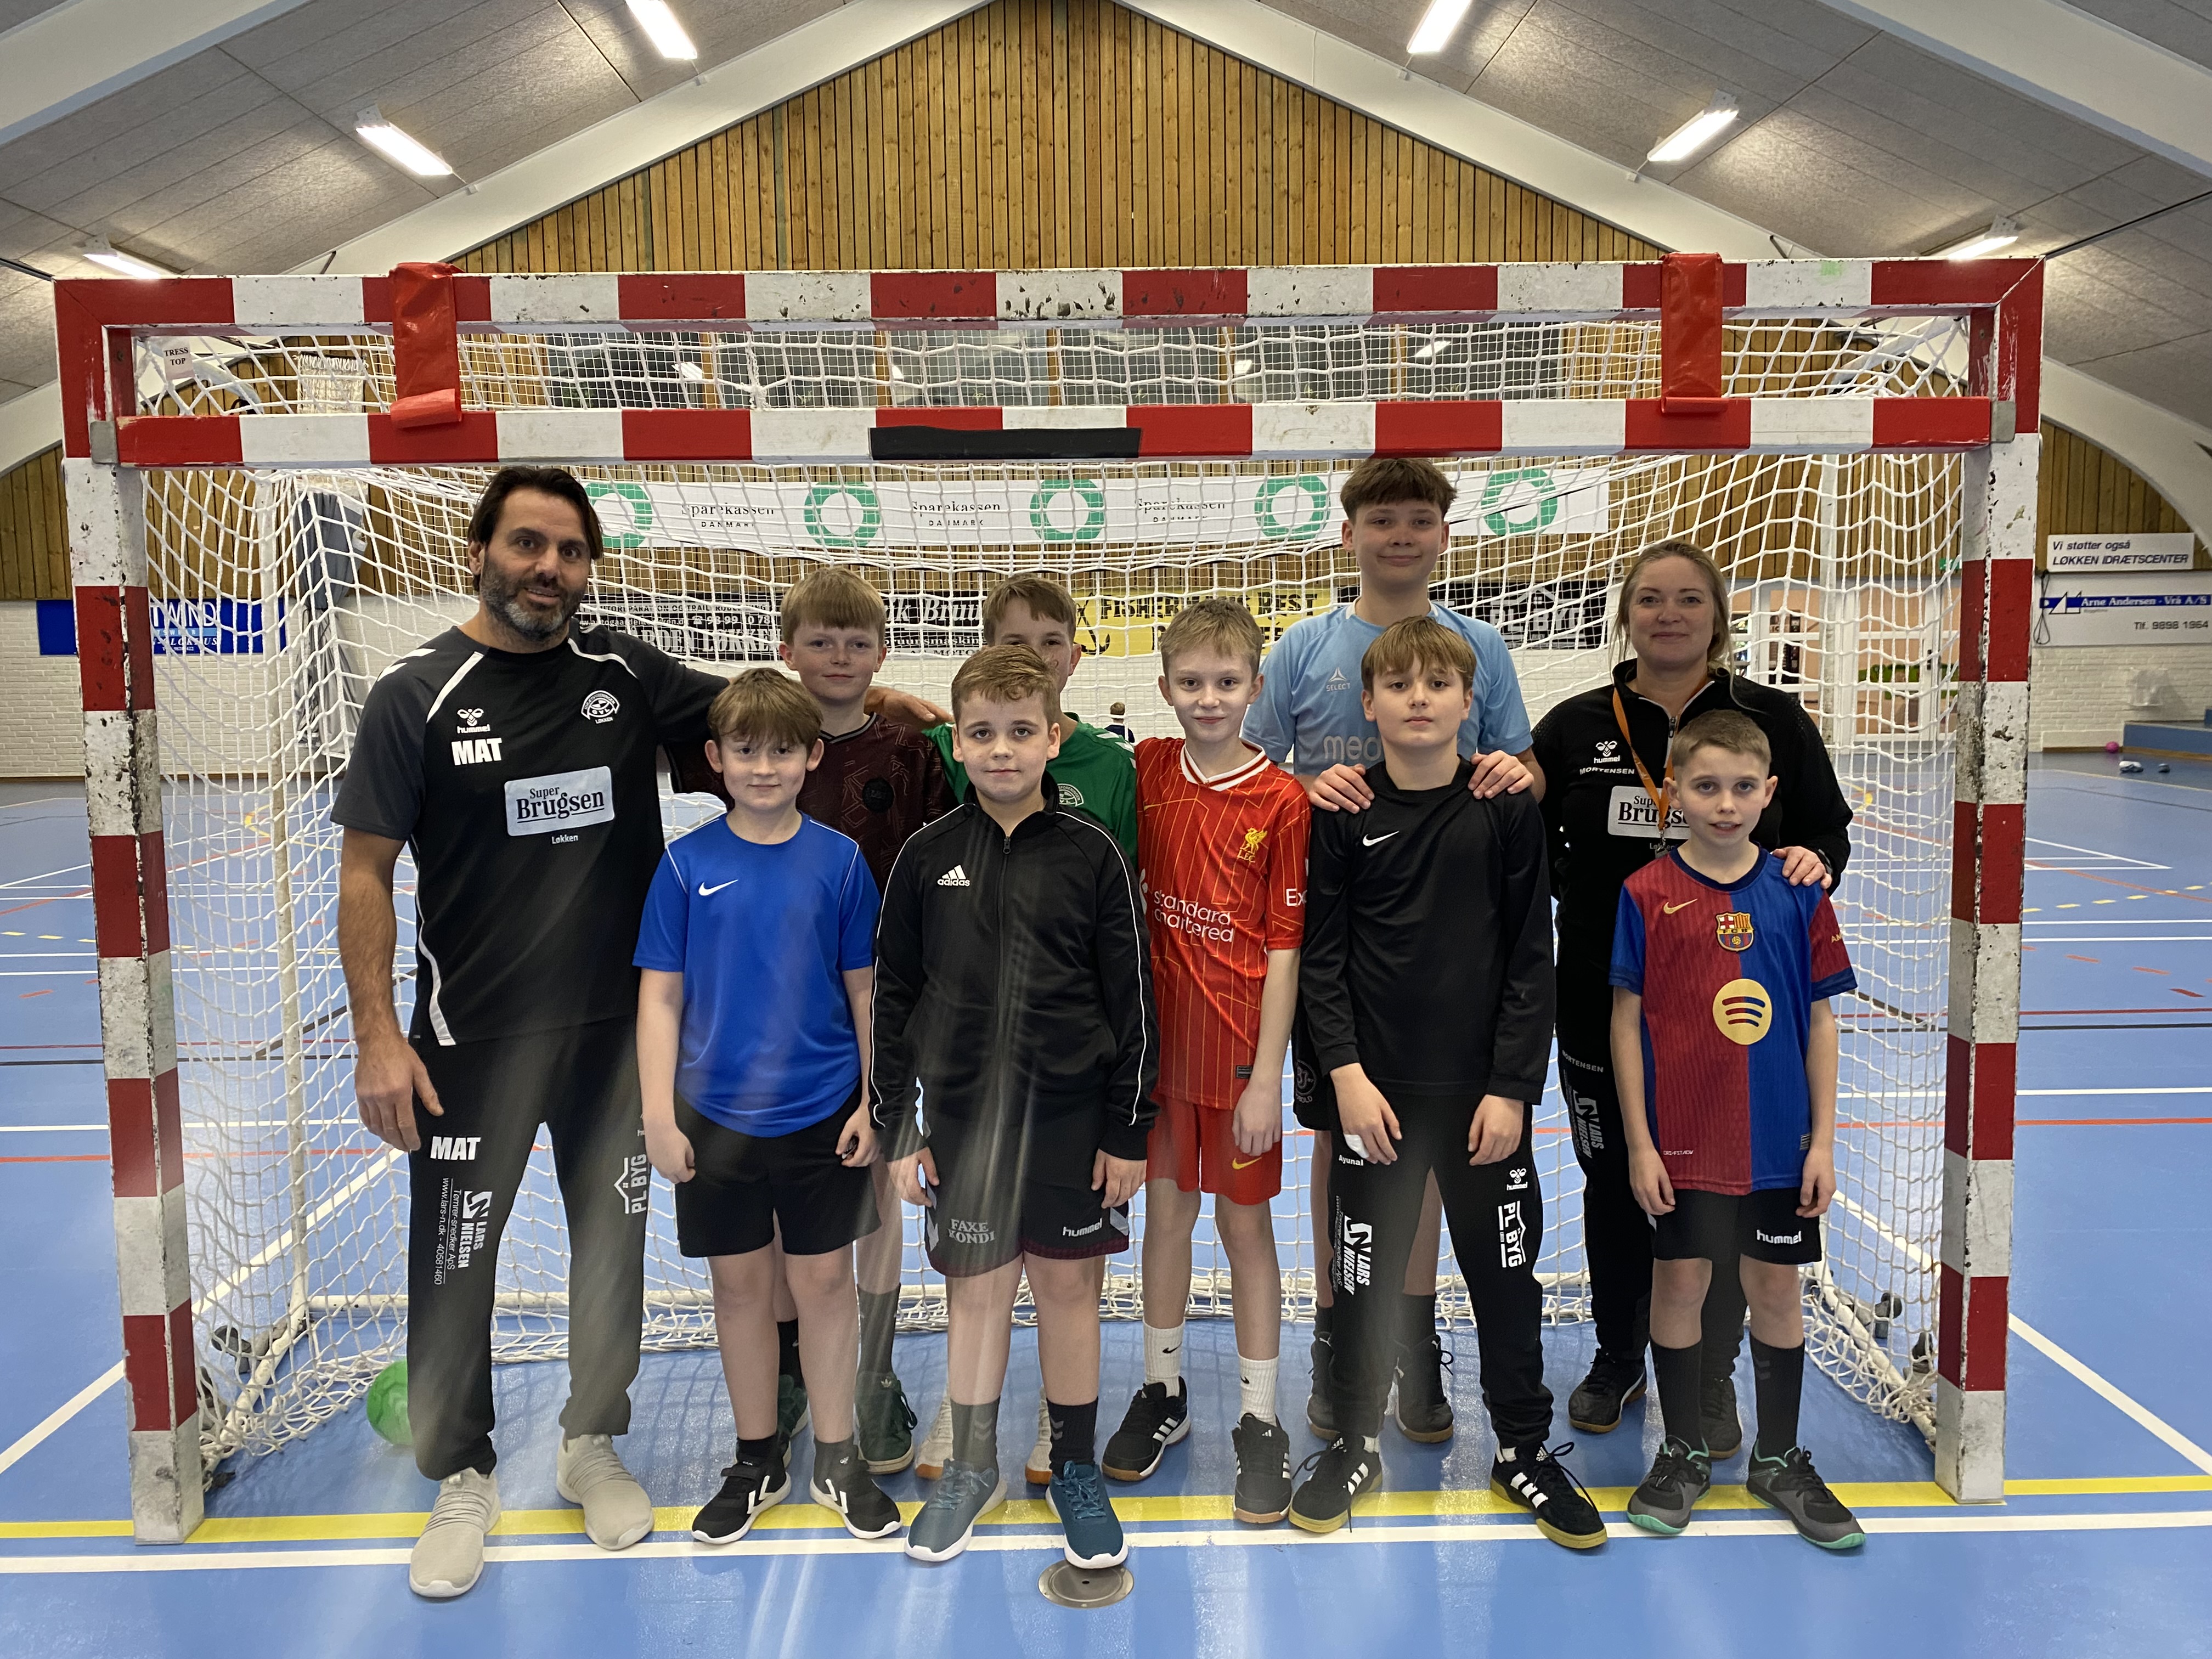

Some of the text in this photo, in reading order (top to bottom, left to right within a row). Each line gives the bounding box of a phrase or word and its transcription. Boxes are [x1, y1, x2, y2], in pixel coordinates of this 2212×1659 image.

[164, 347, 189, 358] TRESS
[171, 358, 187, 366] TOP
[2053, 539, 2131, 551] Vi støtter også
[2053, 554, 2189, 565] LØKKEN IDRÆTSCENTER
[923, 598, 980, 621] Bruu
[2081, 597, 2106, 607] Arne
[2109, 597, 2156, 606] Andersen
[2185, 595, 2208, 605] A/S
[150, 601, 216, 627] TWND
[724, 616, 738, 625] 99
[744, 616, 755, 624] 0
[758, 616, 771, 624] 78
[1326, 683, 1351, 692] SELECT
[457, 724, 490, 734] hummel
[451, 737, 503, 766] MAT
[1593, 755, 1621, 764] hummel
[1579, 767, 1635, 775] MORTENSEN
[529, 786, 560, 800] Super
[1633, 795, 1657, 809] Sup
[516, 791, 605, 820] Brugsen
[551, 834, 579, 844] Løkken
[937, 877, 970, 887] adidas
[1576, 1115, 1593, 1159] NIELSEN
[1588, 1122, 1605, 1149] LARS
[430, 1136, 482, 1161] MAT
[630, 1154, 647, 1188] BYG
[438, 1177, 449, 1236] www.lars-n.dk
[631, 1189, 647, 1214] PL
[447, 1189, 462, 1270] Tømrer-snedker ApS
[473, 1221, 487, 1250] LARS
[950, 1218, 989, 1233] FAXE
[1062, 1218, 1104, 1238] hummel
[1503, 1201, 1522, 1268] PL BYG
[458, 1222, 475, 1268] NIELSEN
[947, 1229, 996, 1244] KONDI
[1756, 1228, 1802, 1245] hummel
[434, 1243, 445, 1285] 40581460
[1344, 1245, 1356, 1296] NIELSEN
[1356, 1253, 1371, 1286] LARS
